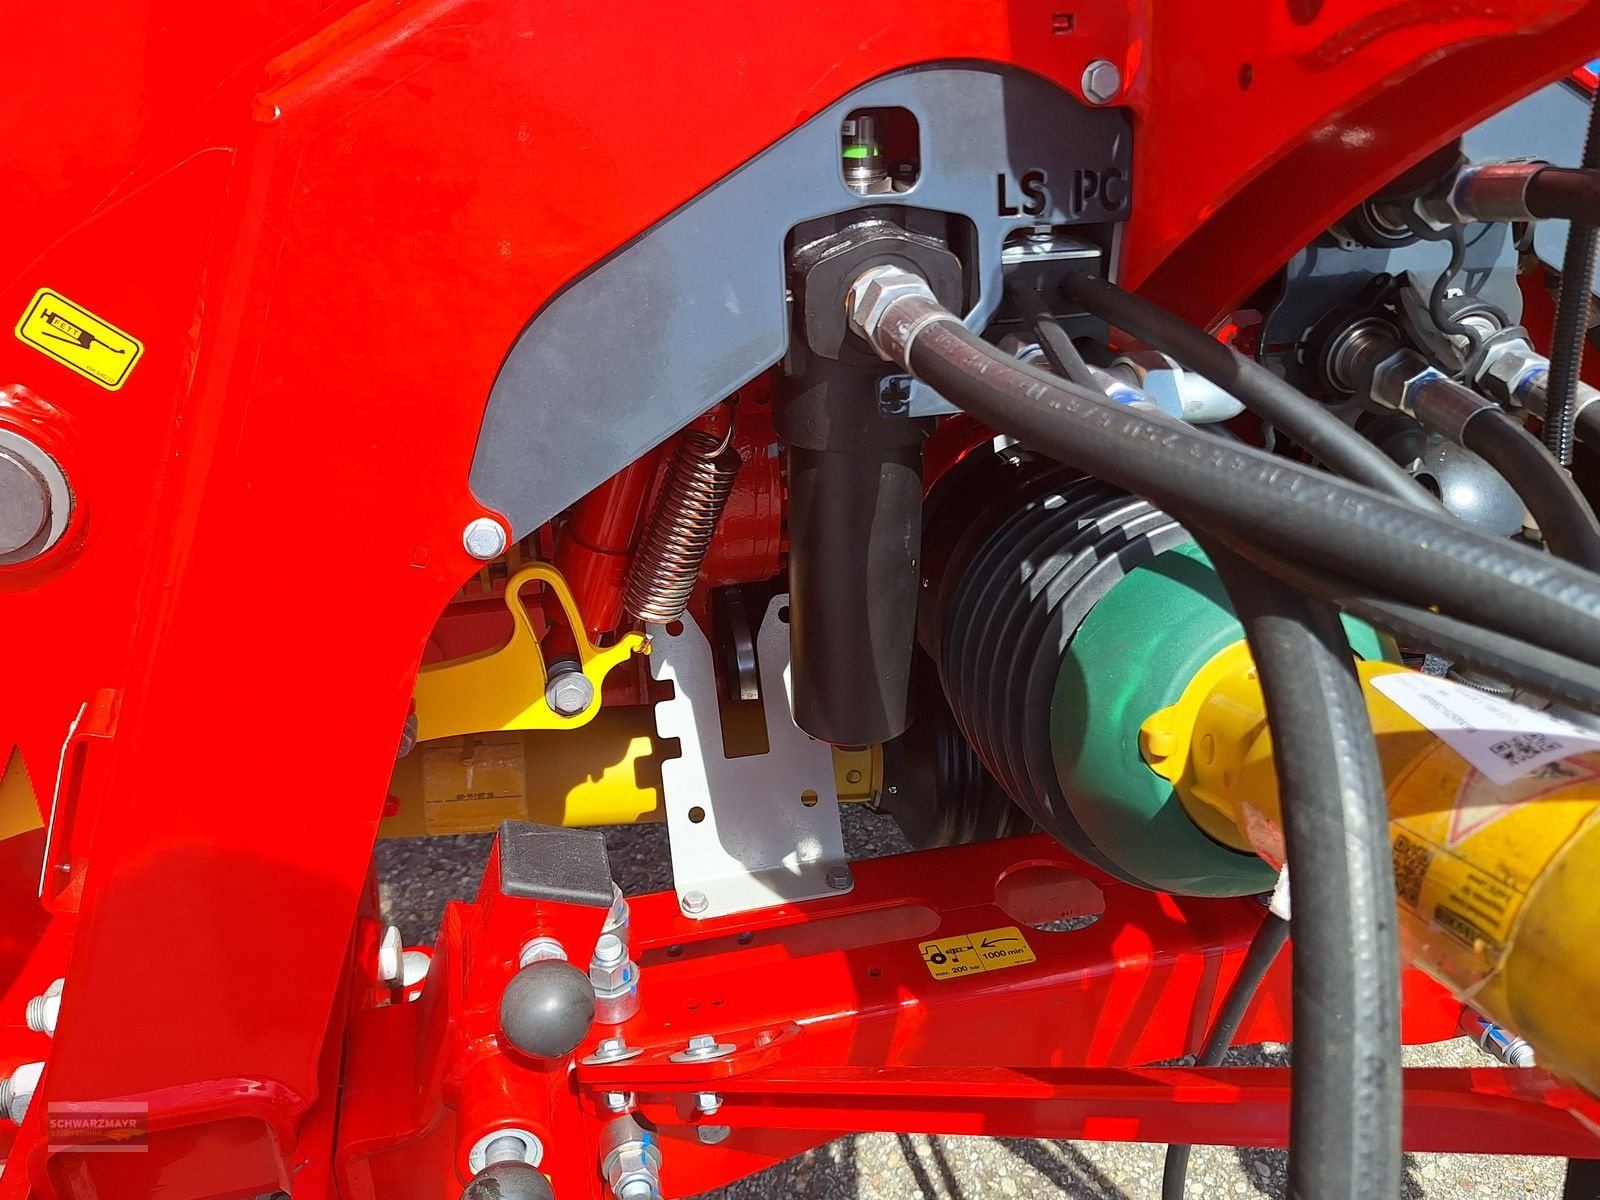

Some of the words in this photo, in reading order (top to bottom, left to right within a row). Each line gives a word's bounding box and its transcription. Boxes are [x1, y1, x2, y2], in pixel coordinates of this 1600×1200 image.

[997, 171, 1046, 217] LS
[1074, 167, 1123, 213] PC
[53, 319, 81, 336] FETT
[982, 950, 1007, 960] 1000
[952, 965, 968, 974] 200
